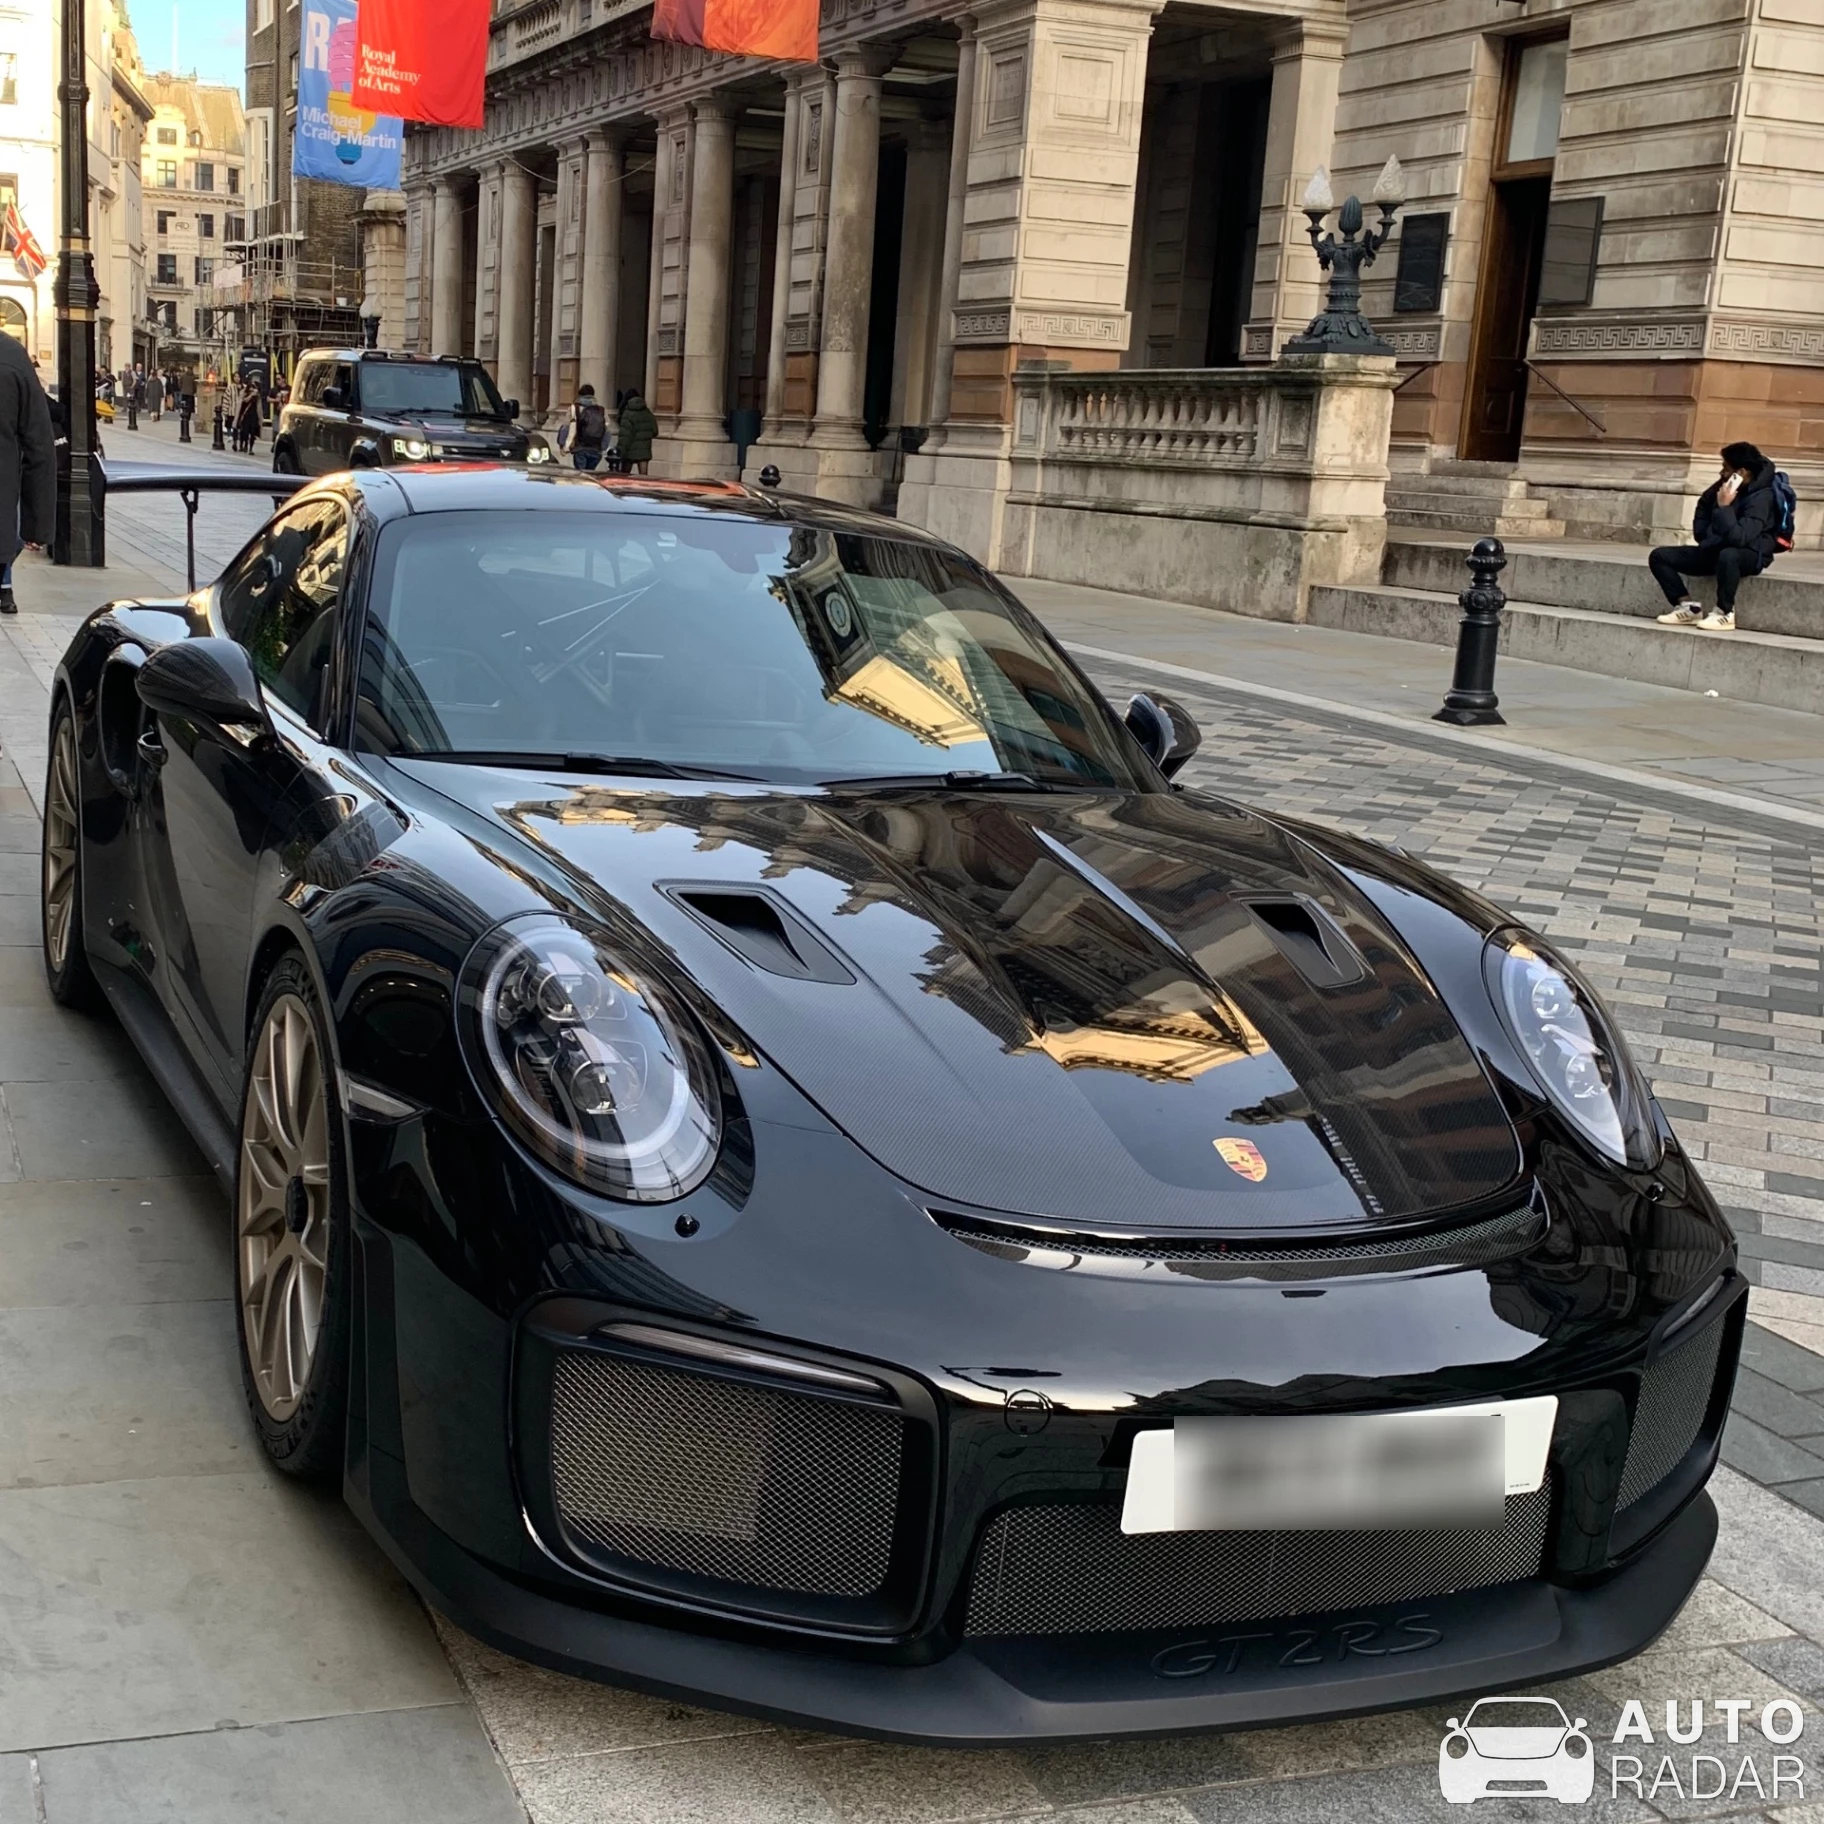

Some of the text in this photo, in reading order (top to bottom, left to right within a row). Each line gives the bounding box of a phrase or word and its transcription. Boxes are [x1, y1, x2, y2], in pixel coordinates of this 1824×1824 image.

[361, 44, 396, 65] Royal
[358, 75, 400, 94] of Arts
[360, 59, 421, 86] Academy
[303, 106, 362, 130] Michael
[301, 123, 396, 149] Craig-Martin
